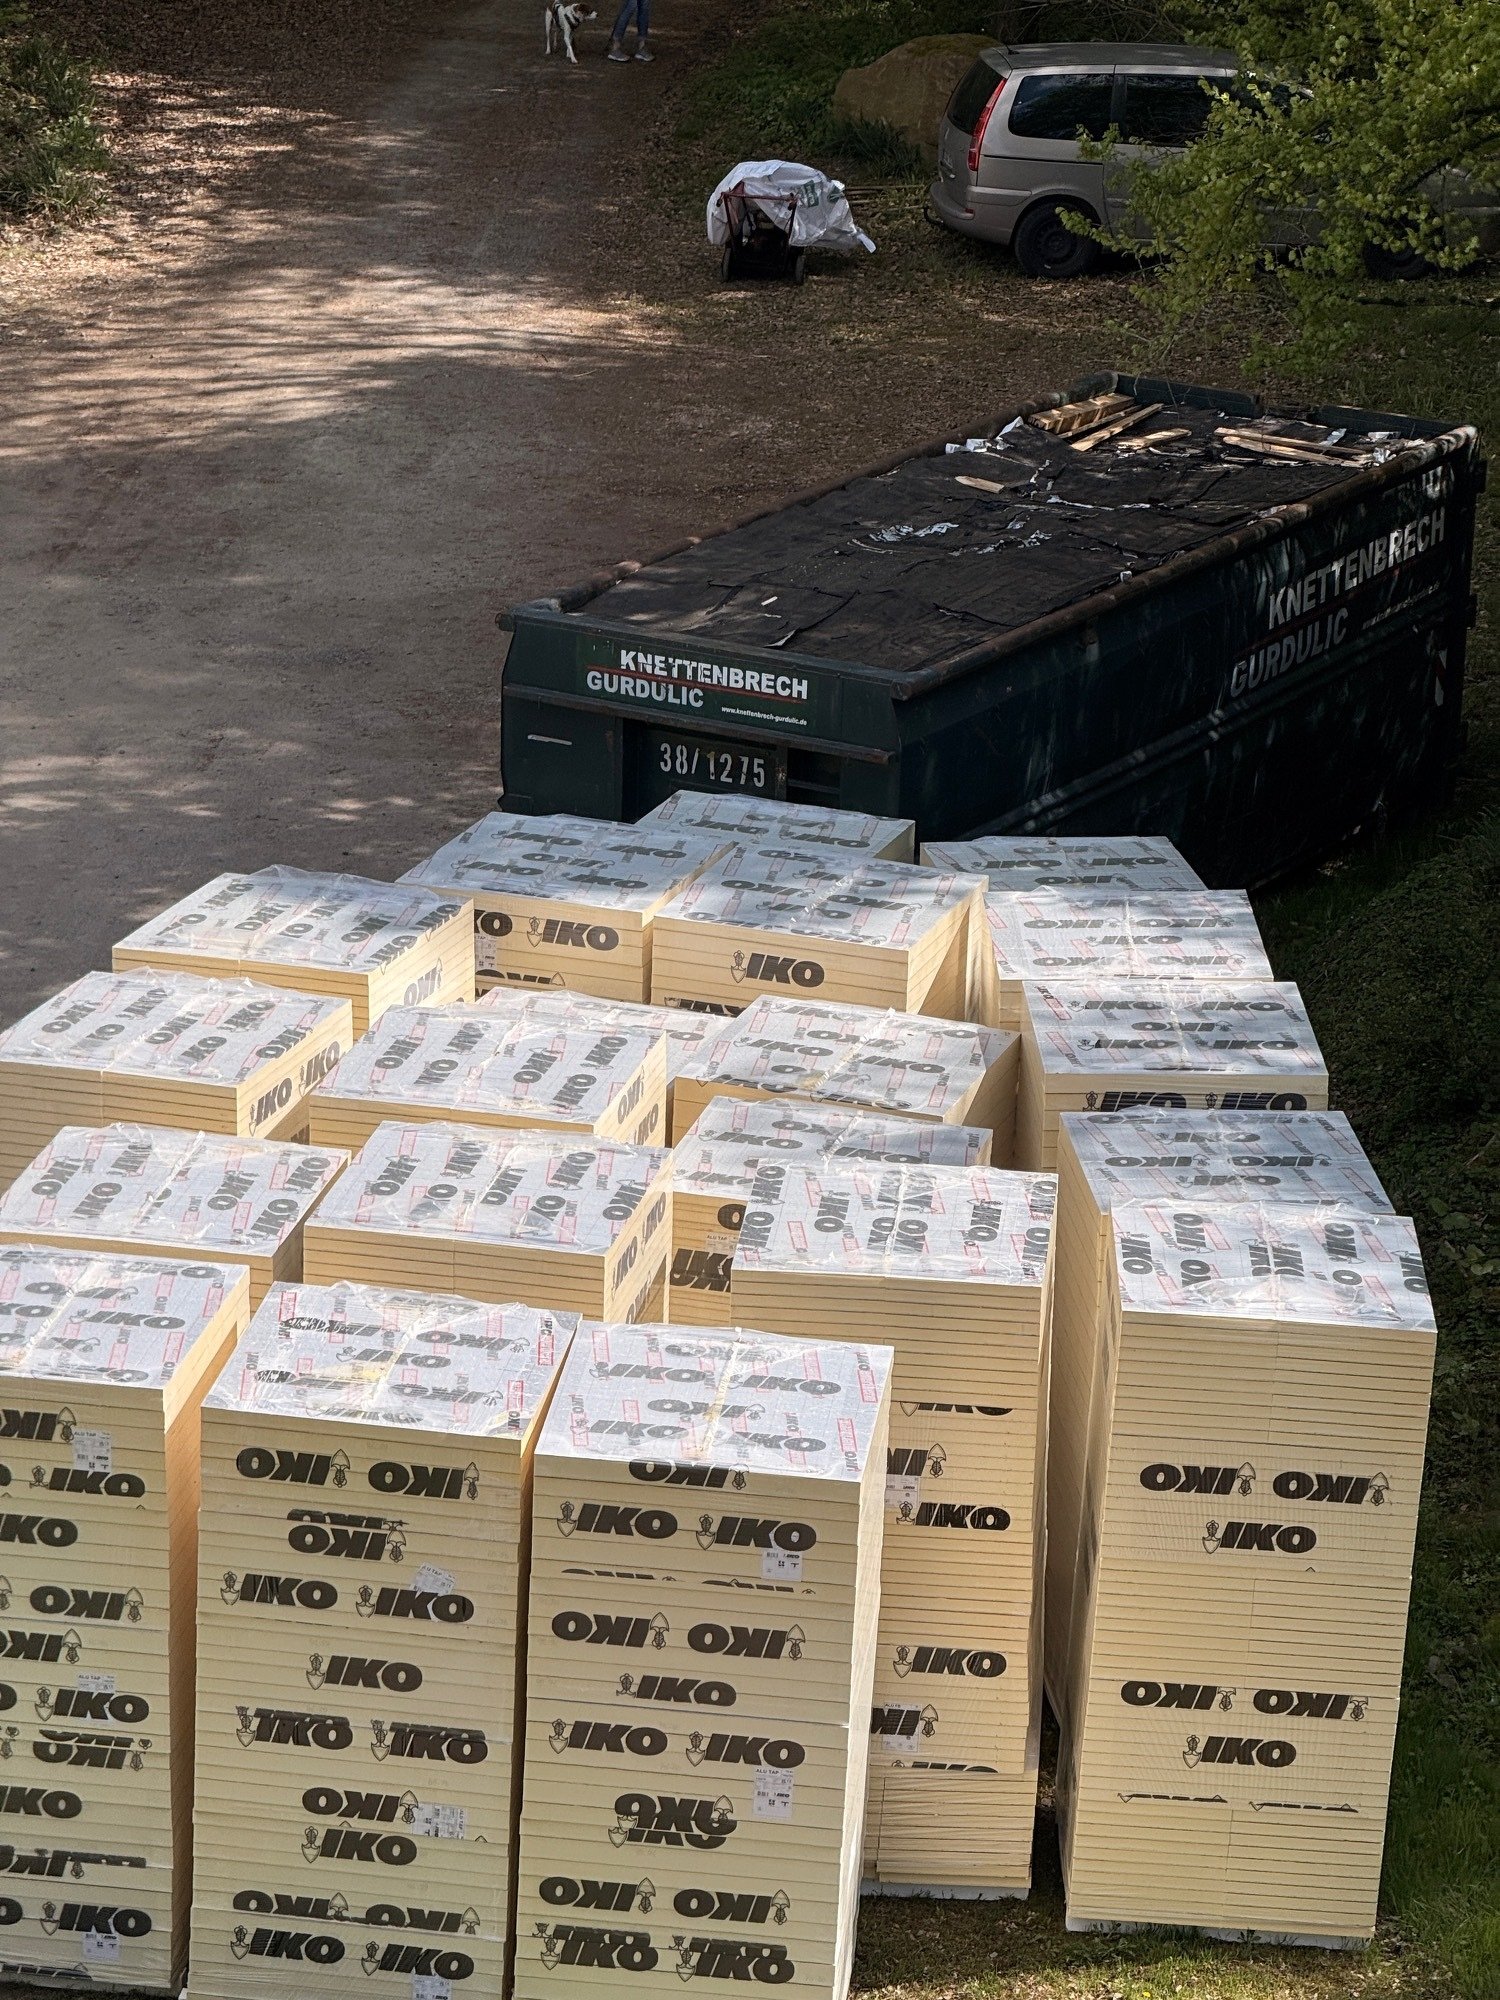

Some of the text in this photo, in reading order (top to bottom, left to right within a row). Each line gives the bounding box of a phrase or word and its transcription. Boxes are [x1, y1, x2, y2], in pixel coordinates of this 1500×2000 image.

[1269, 507, 1446, 630] KNETTENBRECH
[1230, 607, 1348, 697] GURDULIC
[587, 671, 704, 707] GURDULIC
[620, 650, 808, 699] KNETTENBRECH
[721, 880, 805, 896] IKO
[827, 895, 914, 911] IKO
[542, 919, 619, 950] IKO
[746, 953, 825, 987] IKO
[306, 1041, 341, 1084] IKO
[375, 1040, 423, 1069] IKO
[514, 1048, 559, 1083] IKO
[586, 1036, 627, 1065] IKO
[750, 1040, 833, 1056] IKO
[862, 1056, 945, 1073] IKO
[256, 1077, 294, 1125] IKO
[553, 1074, 596, 1107] IKO
[714, 1131, 803, 1149] IKO
[834, 1147, 922, 1164] IKO
[32, 1158, 83, 1195] IKO
[286, 1157, 330, 1190] IKO
[370, 1158, 419, 1196] IKO
[551, 1151, 597, 1186] IKO
[1105, 1156, 1193, 1167] IKO
[208, 1171, 256, 1210] IKO
[751, 1165, 786, 1200] IKO
[1030, 1181, 1057, 1214] IKO
[72, 1182, 122, 1219] IKO
[602, 1184, 647, 1221] IKO
[645, 1192, 666, 1244] IKO
[814, 1195, 849, 1232] IKO
[250, 1199, 298, 1239] IKO
[738, 1211, 774, 1248] IKO
[896, 1219, 928, 1252] IKO
[1174, 1213, 1206, 1247] IKO
[1022, 1228, 1050, 1262] IKO
[1121, 1238, 1153, 1274] IKO
[1325, 1223, 1357, 1258] IKO
[616, 1236, 637, 1290] IKO
[87, 1311, 186, 1330] IKO
[608, 1363, 705, 1382] IKO
[742, 1374, 841, 1395] IKO
[0, 1409, 58, 1440] IK
[589, 1420, 688, 1438] IKO
[728, 1432, 826, 1451] IKO
[49, 1467, 146, 1497] IKO
[236, 1447, 464, 1499] IKO IKO
[629, 1458, 730, 1488] IKO
[1140, 1463, 1372, 1505] IKO IKO
[0, 1514, 78, 1547] KO
[576, 1503, 817, 1551] IKO IKO
[916, 1502, 1010, 1530] IKO
[288, 1525, 387, 1561] IKO
[1219, 1521, 1317, 1553] IKO
[30, 1586, 125, 1621] IKO
[240, 1574, 474, 1622] IKO IKO
[0, 1630, 63, 1662] IK
[552, 1611, 788, 1659] IKO IKO
[325, 1656, 422, 1692] IKO
[911, 1647, 1007, 1678] IKO
[54, 1689, 149, 1723] IKO
[636, 1675, 737, 1707] IKO
[1120, 1681, 1351, 1719] IKO IKO
[568, 1721, 805, 1768] IKO IKO
[1199, 1736, 1297, 1768] IKO
[302, 1787, 400, 1822] IKO
[320, 1828, 417, 1865] IKO
[539, 1876, 773, 1923] IKO IKO
[59, 1903, 151, 1937] IKO
[249, 1928, 474, 1980] IKO IKO
